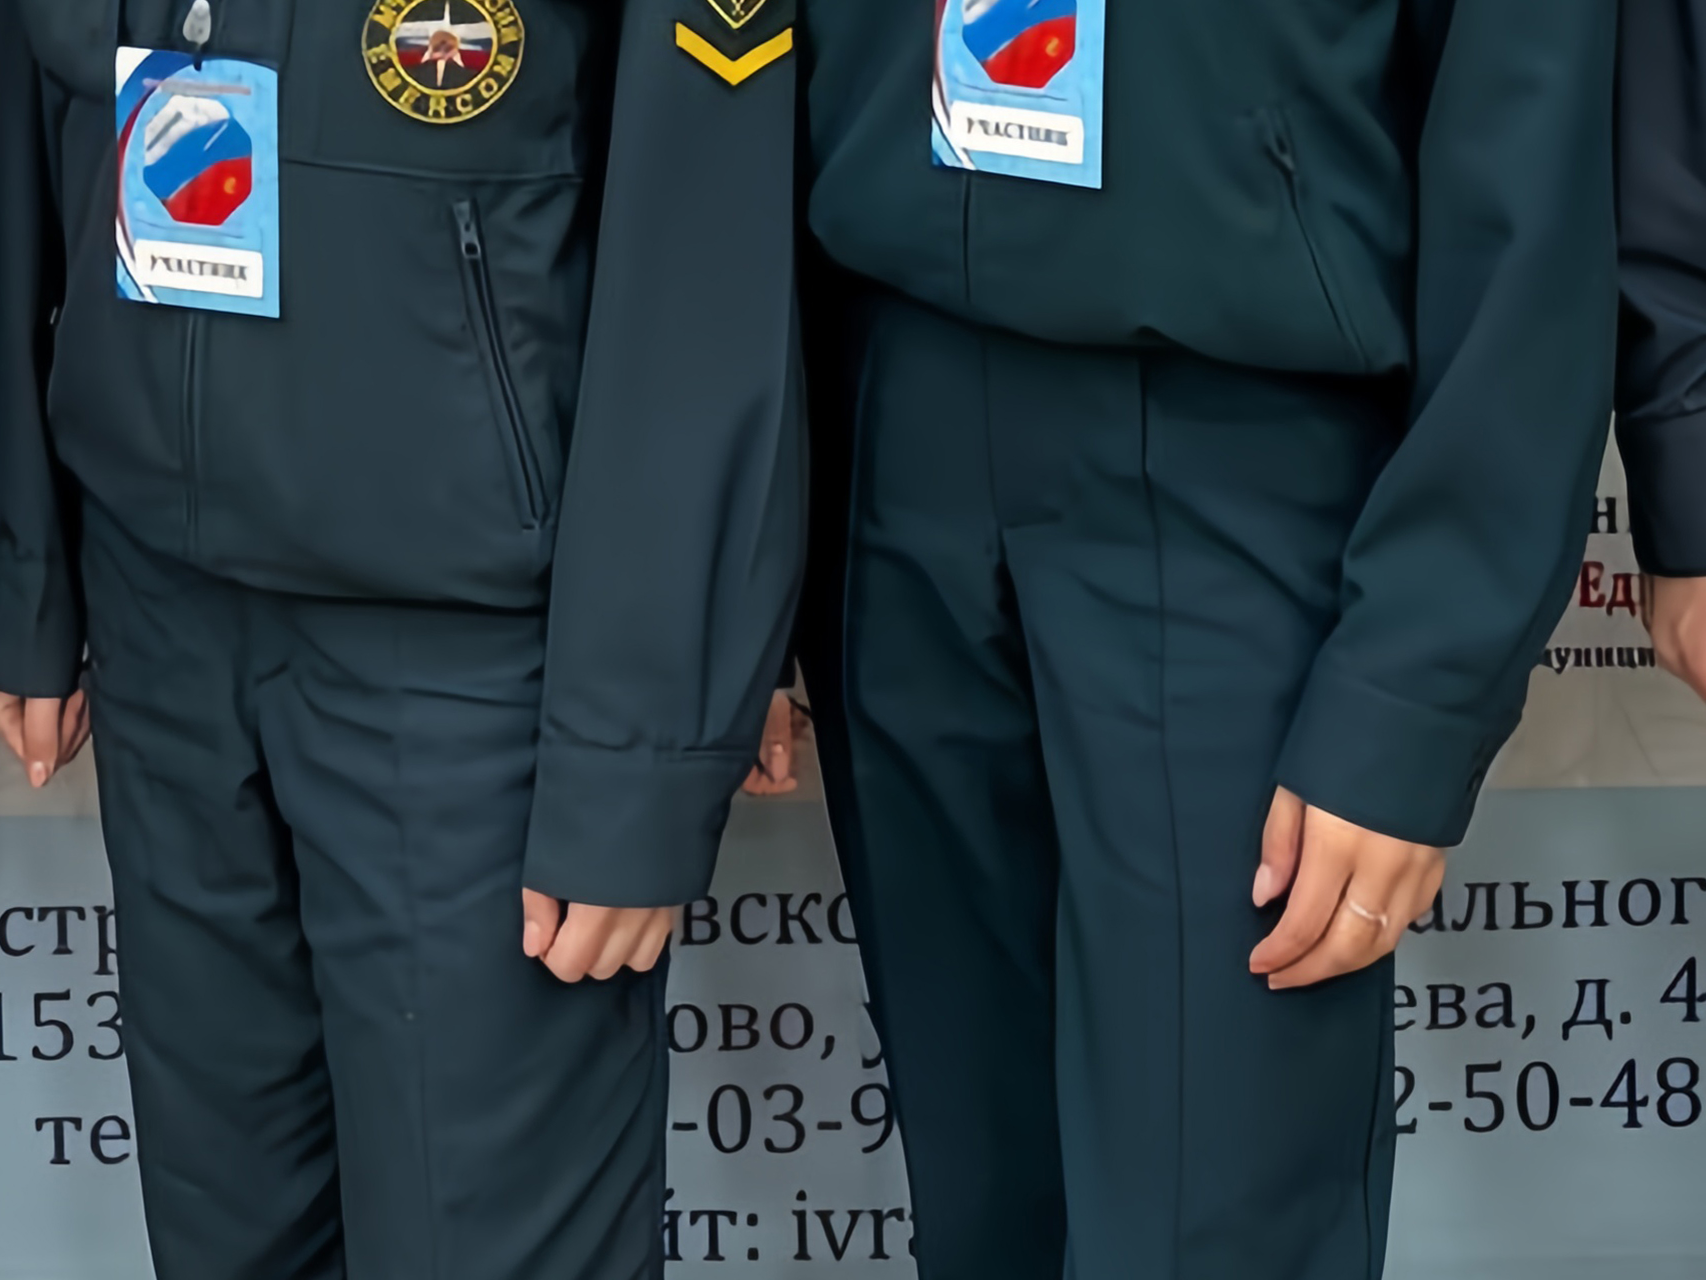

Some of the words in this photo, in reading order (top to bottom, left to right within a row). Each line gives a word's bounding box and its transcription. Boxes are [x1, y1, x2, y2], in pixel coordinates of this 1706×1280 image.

[1562, 979, 1631, 1041] д.
[34, 1114, 132, 1166] те
[672, 1084, 894, 1154] -03-9
[791, 1188, 915, 1262] ivr
